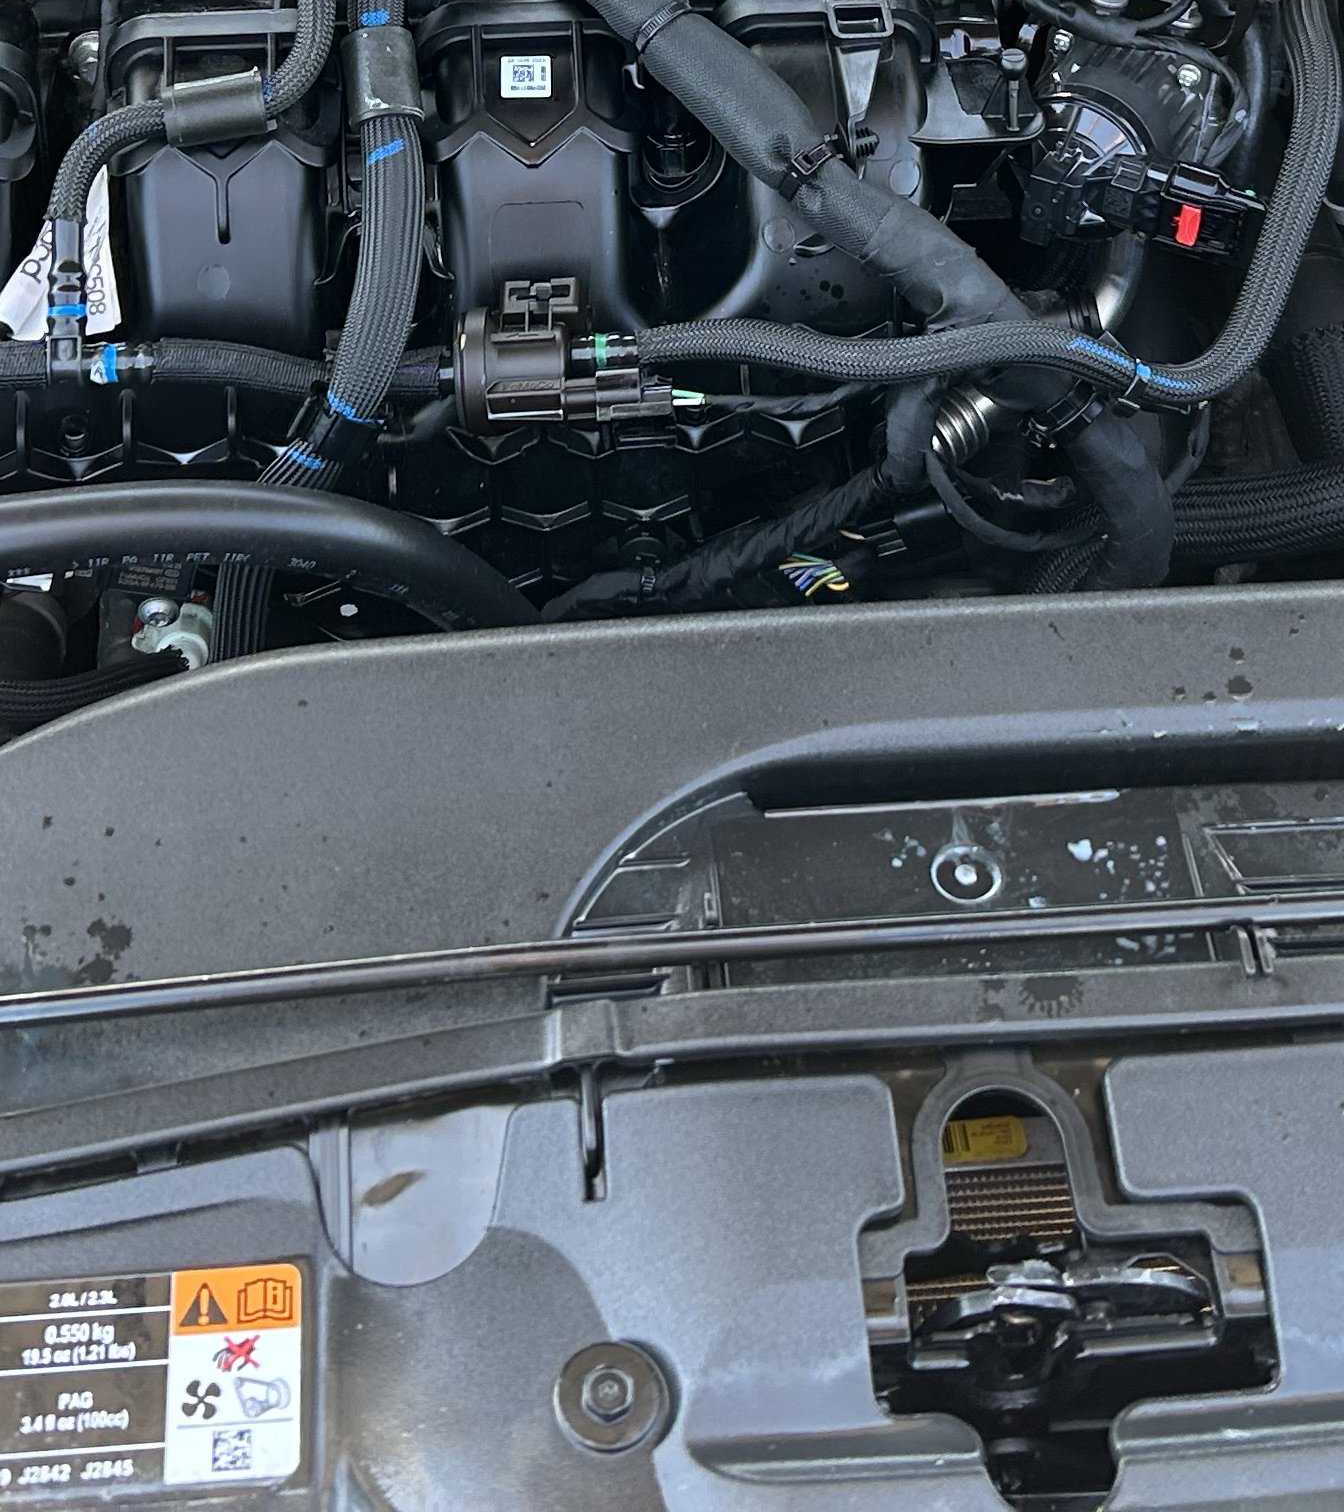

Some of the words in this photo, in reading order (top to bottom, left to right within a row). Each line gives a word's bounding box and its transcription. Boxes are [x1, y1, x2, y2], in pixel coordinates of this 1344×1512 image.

[44, 1322, 90, 1345] 0.550
[92, 1321, 115, 1345] kg
[58, 1390, 94, 1410] PAG
